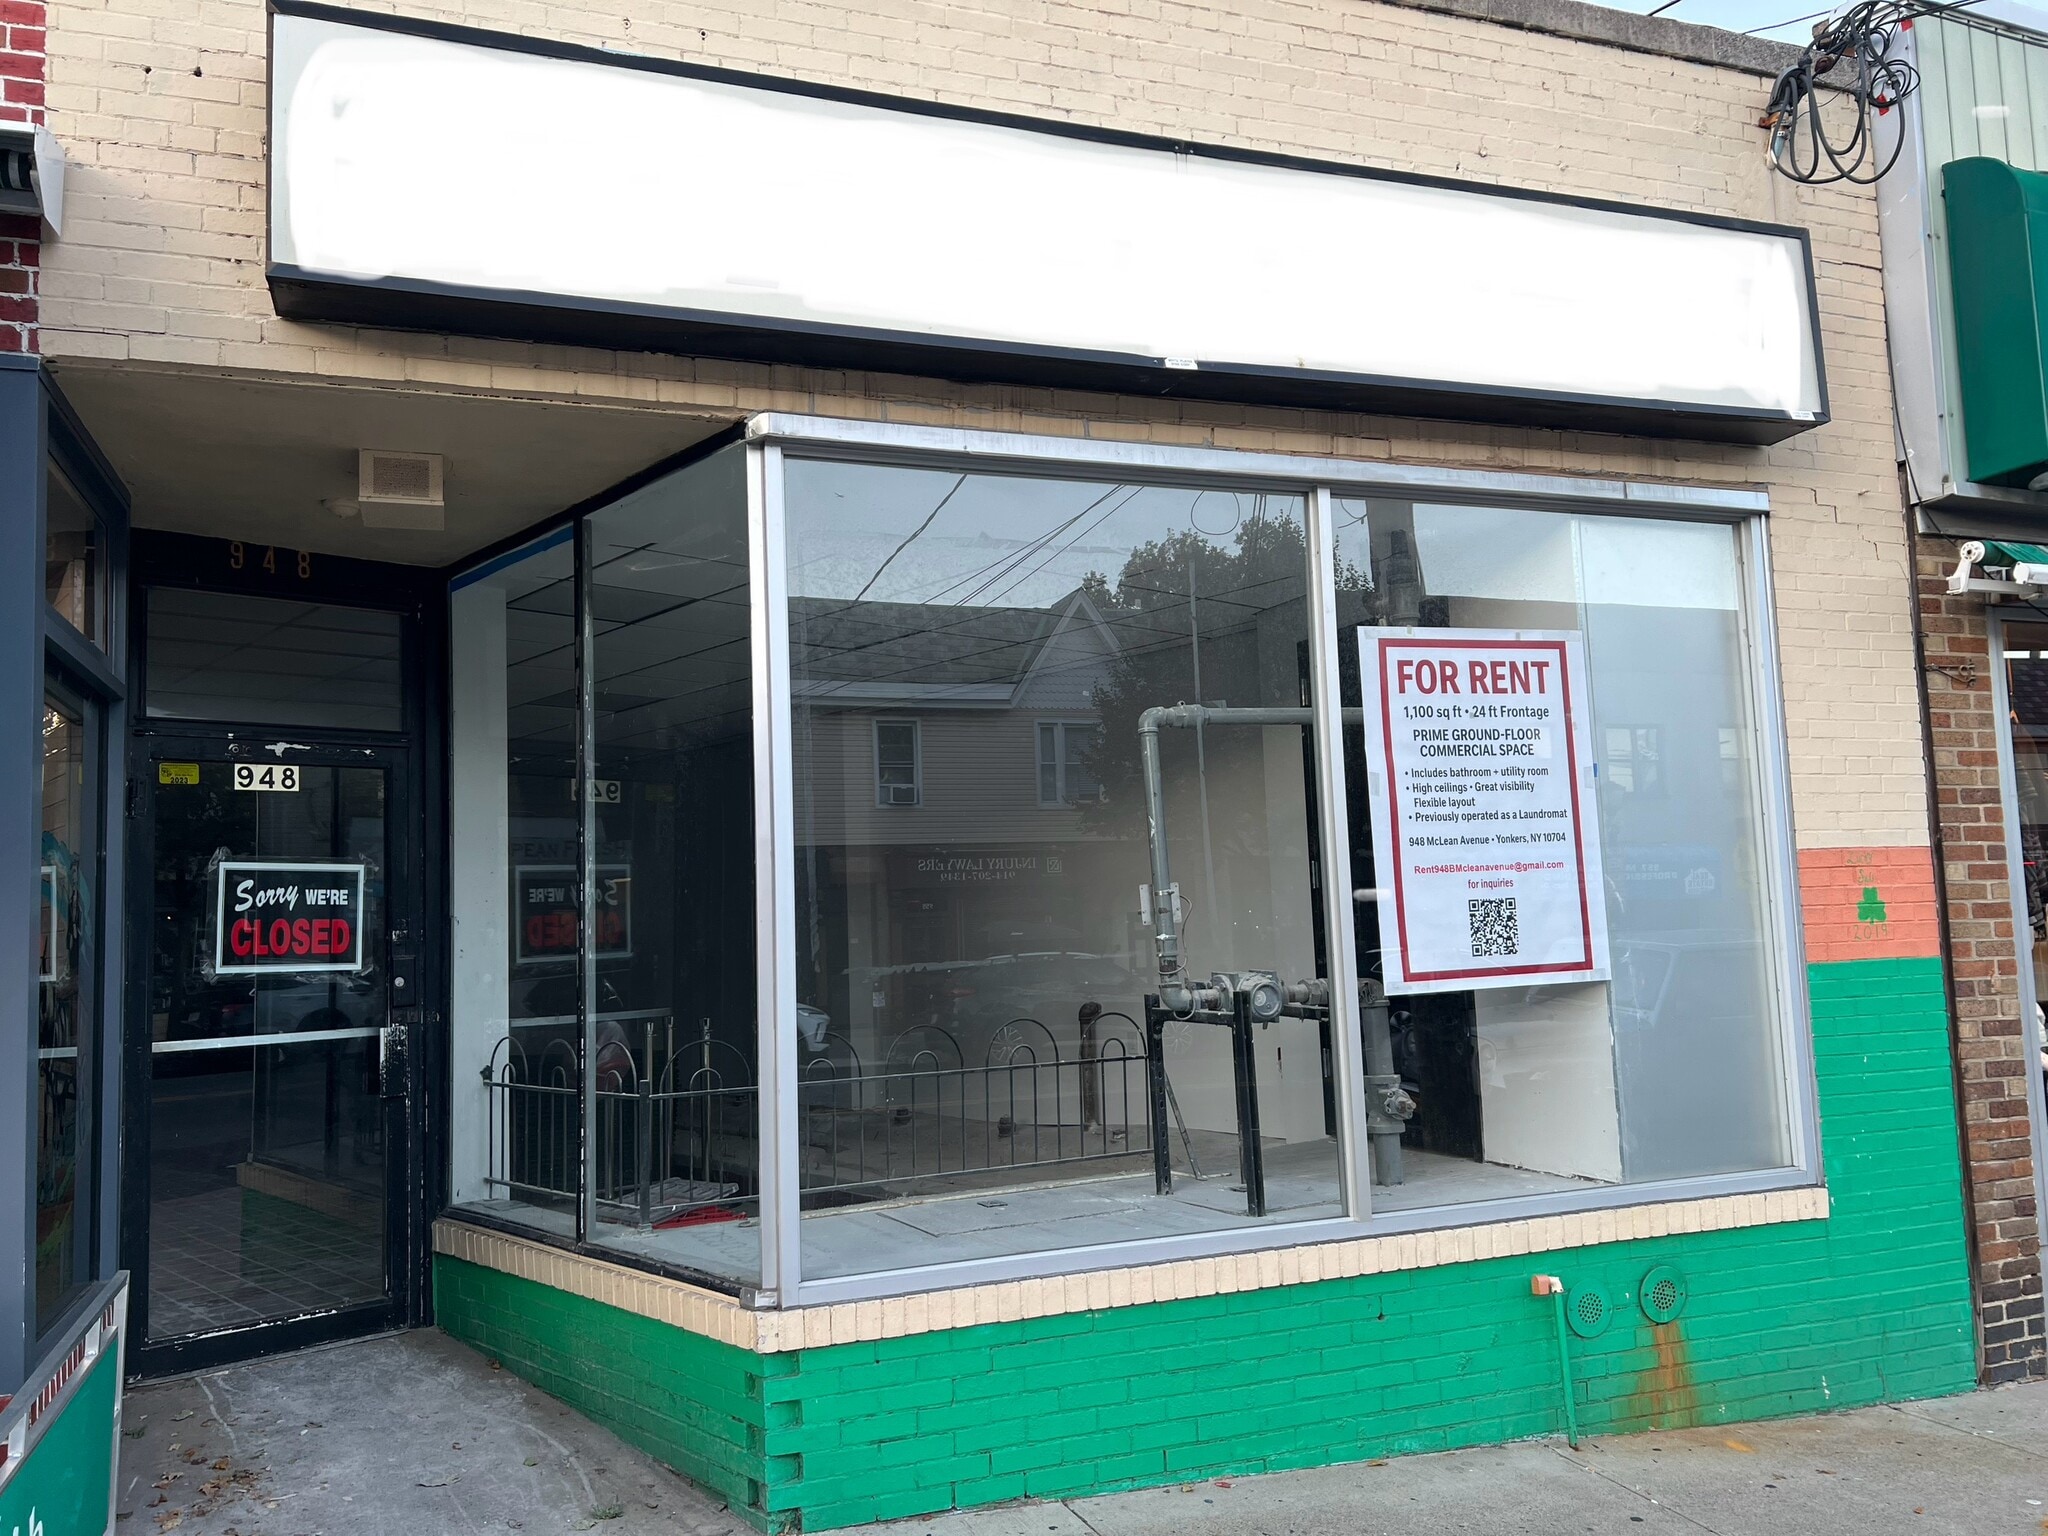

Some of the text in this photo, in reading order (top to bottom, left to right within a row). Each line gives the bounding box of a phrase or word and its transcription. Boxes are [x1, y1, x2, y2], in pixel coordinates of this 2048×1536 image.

[230, 541, 311, 578] 948
[1397, 659, 1550, 694] FOR RENT
[1403, 705, 1550, 720] 1,100 sq ft 24 ft Frontage
[1413, 728, 1541, 741] PRIME GROUND-FLOOR
[1420, 743, 1535, 757] COMMERCIAL SPACE
[237, 766, 296, 789] 948
[1411, 768, 1448, 778] Includes
[1450, 767, 1492, 778] bathroom
[1501, 766, 1526, 779] utility
[1527, 767, 1549, 776] room
[170, 777, 189, 785] 2023
[1412, 781, 1535, 795] High ceilings Great visibility
[1414, 797, 1476, 809] Flexible layout
[1415, 809, 1568, 823] Previously operated as a Laundromat
[1409, 832, 1566, 847] 948 McLean Avenue Yonkers, NY 10704
[1468, 878, 1514, 890] for inquiries
[234, 879, 349, 912] Sorry WE'RE
[231, 918, 350, 956] CLOSED
